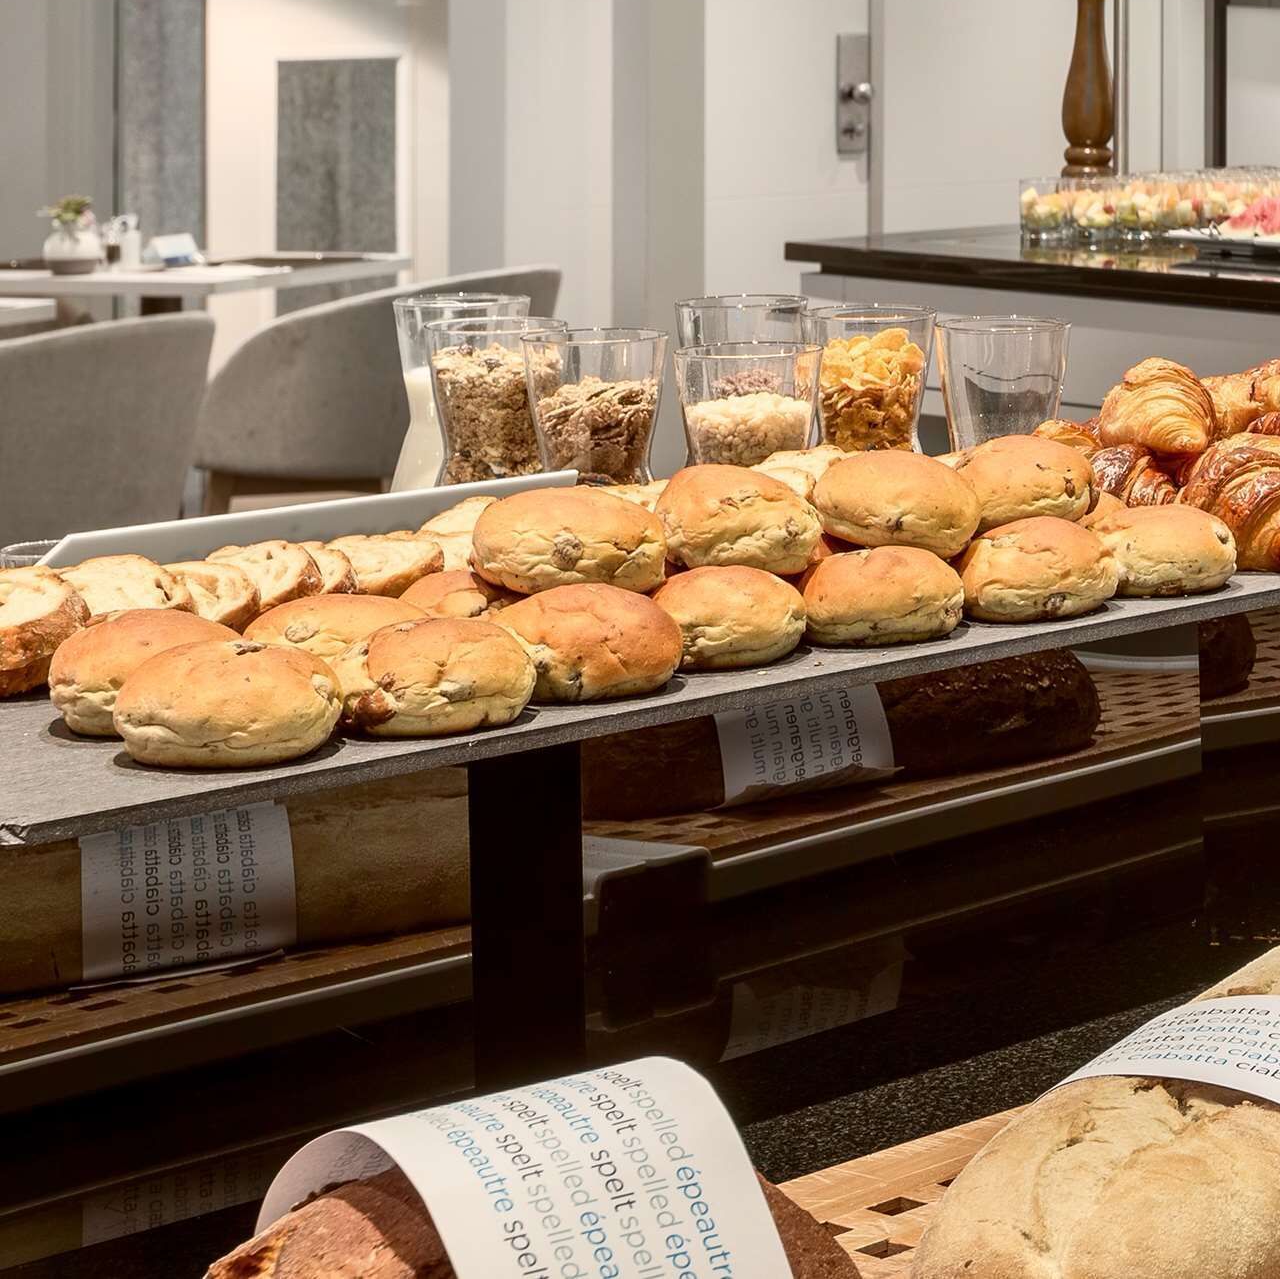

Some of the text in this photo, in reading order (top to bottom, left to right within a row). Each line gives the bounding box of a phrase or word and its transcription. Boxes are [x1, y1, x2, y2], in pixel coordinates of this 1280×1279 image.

[446, 1127, 515, 1213] épeautre
[501, 1098, 550, 1129] spelt
[534, 1127, 599, 1208] spelled
[588, 1091, 640, 1135] spelt
[622, 1136, 684, 1230] spelled
[628, 1089, 695, 1162] spelled
[495, 1133, 545, 1182] spelt
[527, 1183, 590, 1279] spelled
[589, 1149, 637, 1213] spelt
